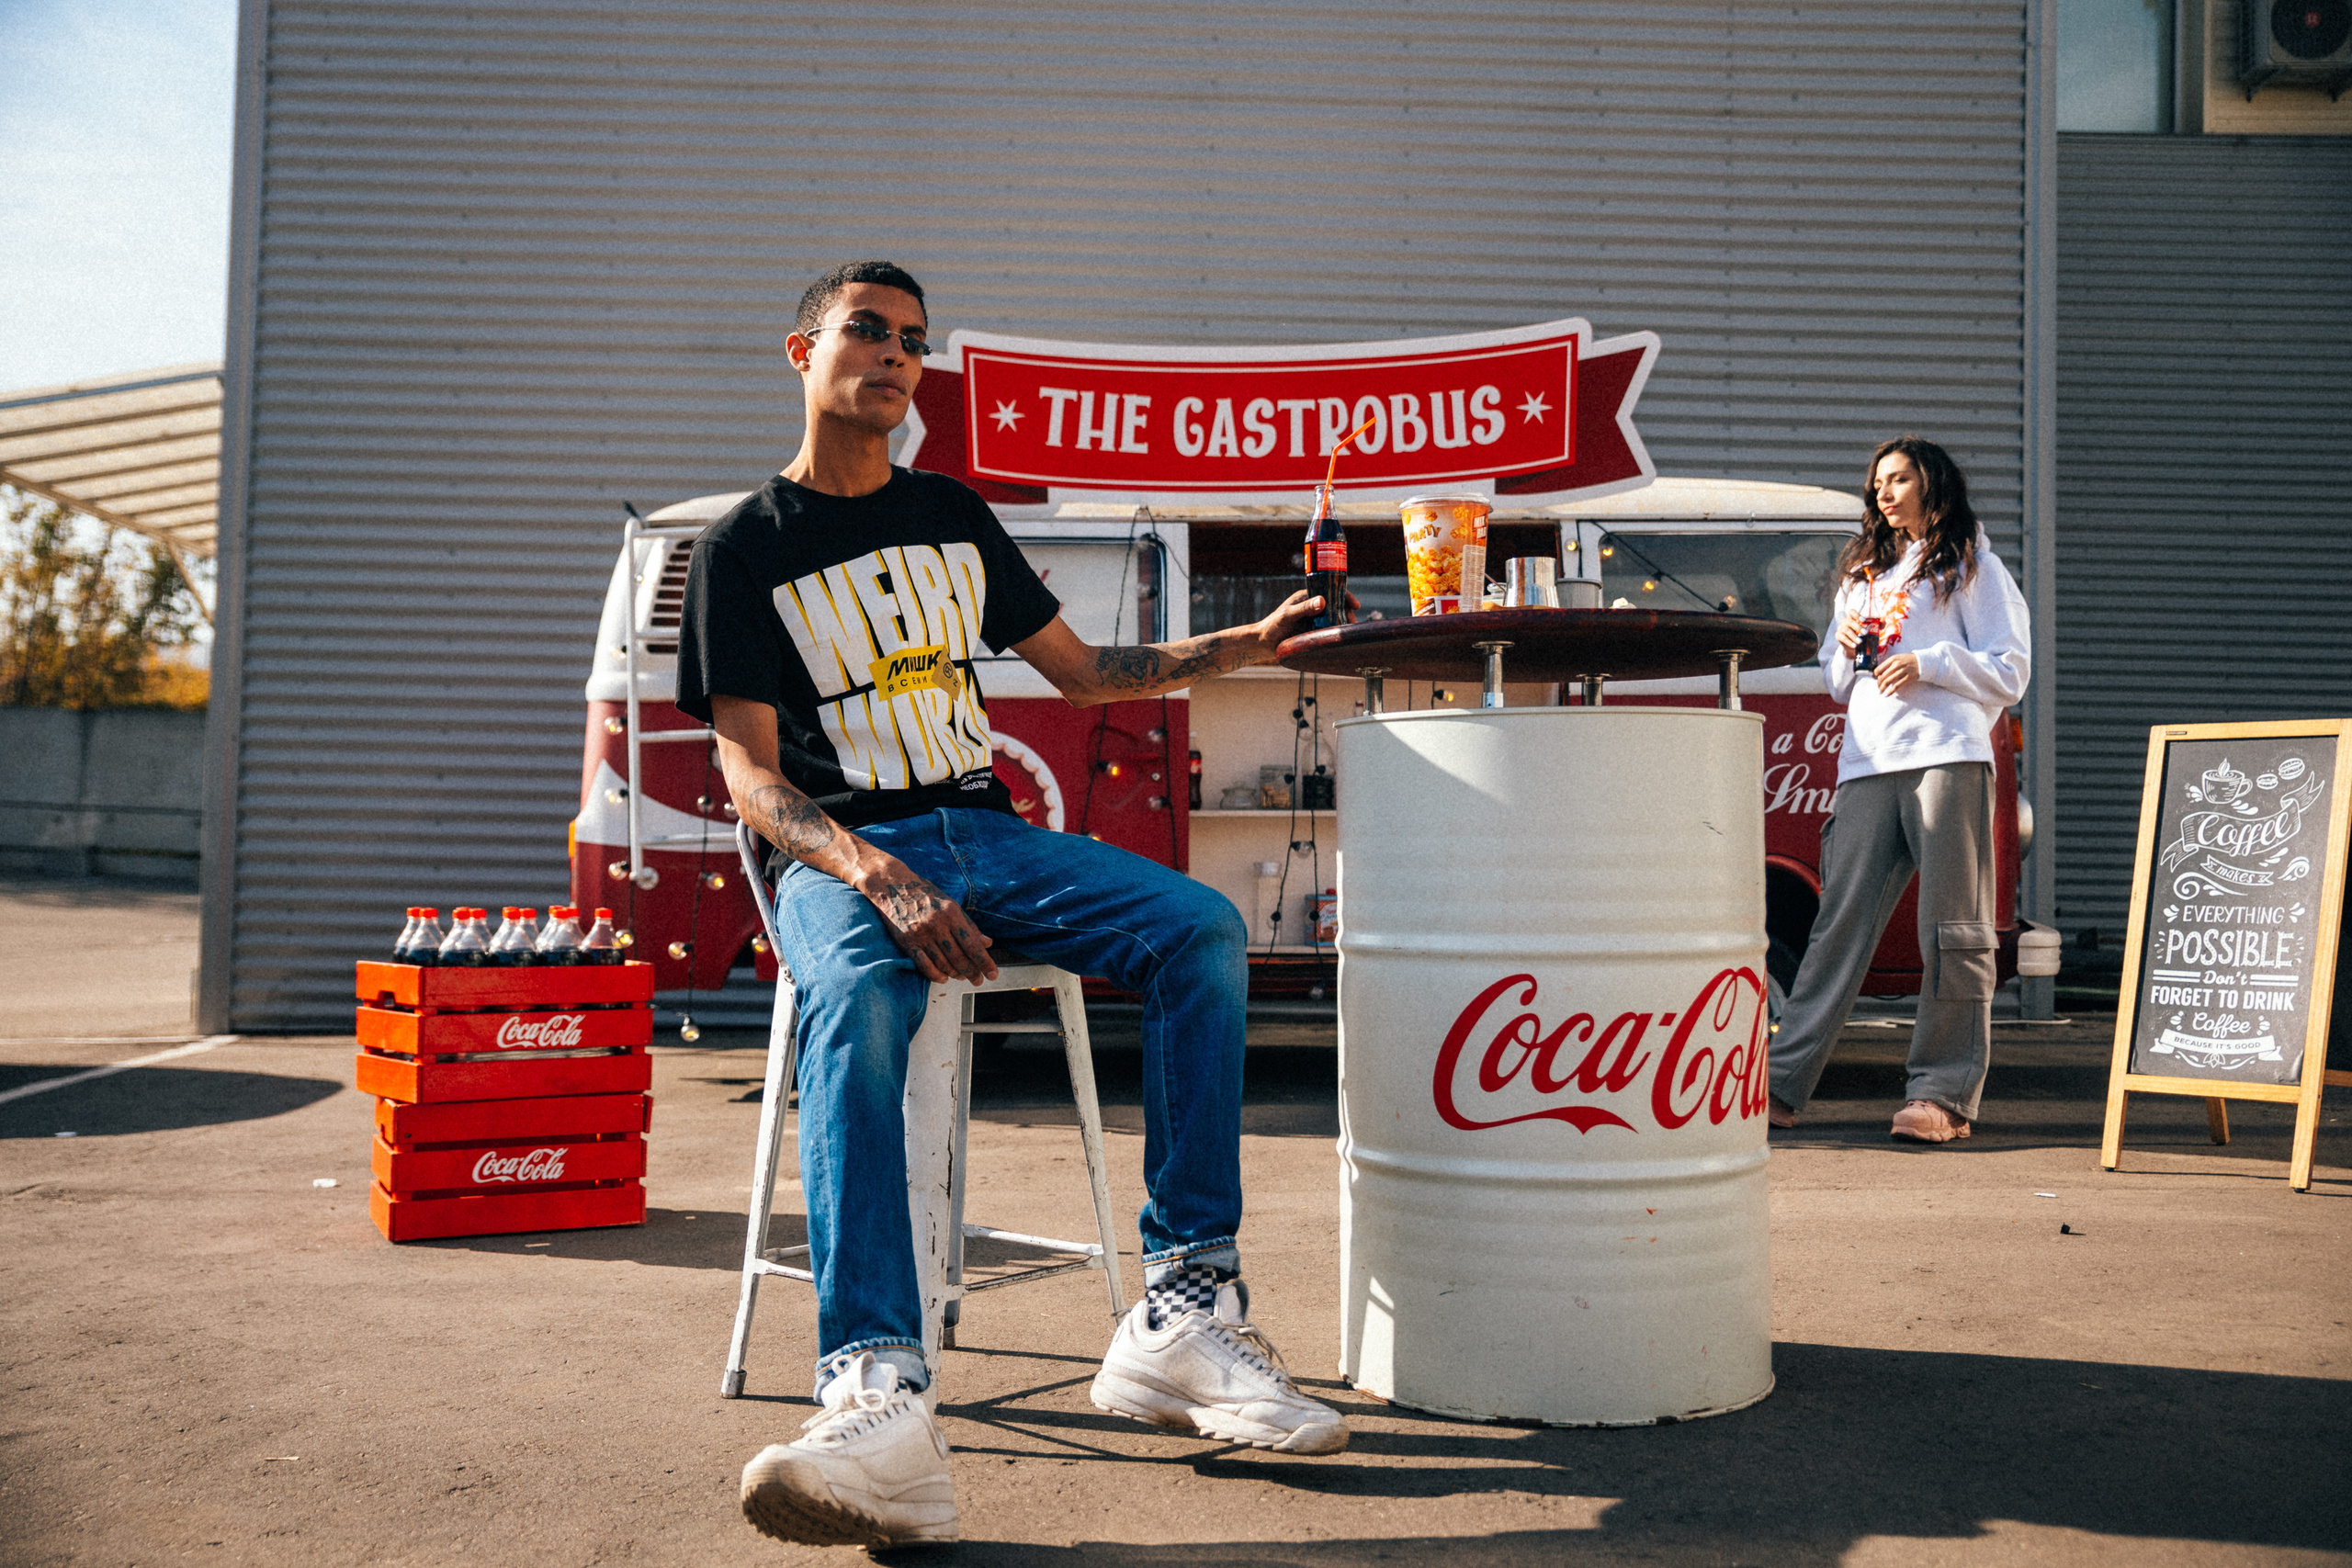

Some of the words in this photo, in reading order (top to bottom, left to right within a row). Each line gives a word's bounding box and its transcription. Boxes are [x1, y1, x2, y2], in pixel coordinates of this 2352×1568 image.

[1040, 387, 1151, 454] THE
[1174, 384, 1506, 458] GASTROBUS
[1409, 524, 1442, 543] PARTY
[773, 542, 987, 698] WEIRD
[887, 650, 942, 681] МИШК
[1771, 733, 1793, 754] a
[1804, 713, 1846, 754] Co
[2198, 812, 2291, 857] Coffee
[2216, 865, 2254, 884] makes
[2182, 905, 2286, 925] EVERYTHING
[2165, 928, 2295, 969] POSSIBLE
[2202, 970, 2248, 986] Don't
[2151, 986, 2213, 1007] FORGET
[2218, 988, 2239, 1009] TO
[2243, 990, 2296, 1011] DRINK
[496, 1014, 586, 1049] Coca-Cola
[2192, 1011, 2252, 1039] Coffee
[2174, 1035, 2213, 1050] BECAUSE
[2234, 1042, 2261, 1050] GOOD
[471, 1148, 569, 1184] Coca-Cola
